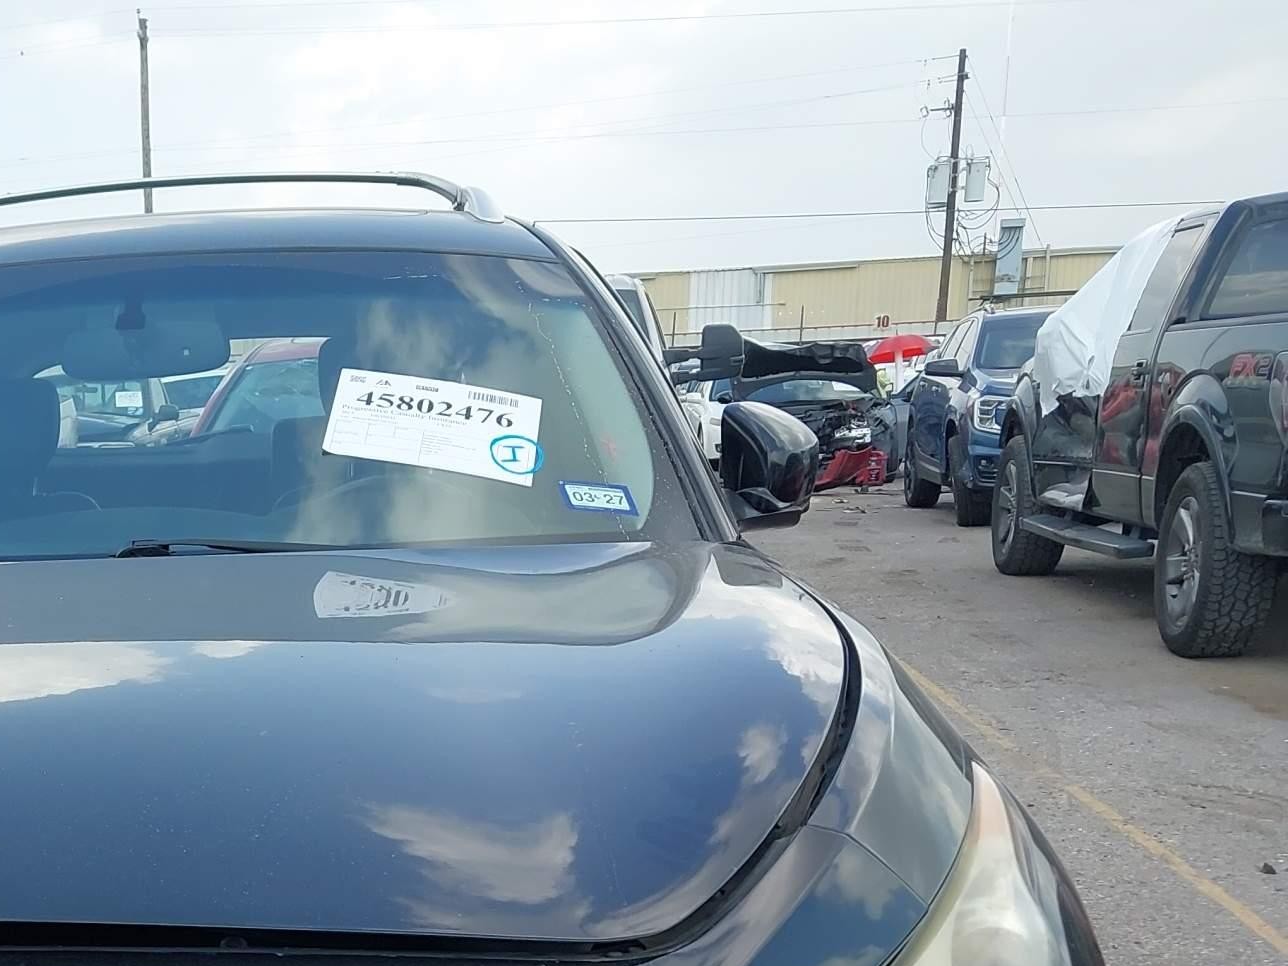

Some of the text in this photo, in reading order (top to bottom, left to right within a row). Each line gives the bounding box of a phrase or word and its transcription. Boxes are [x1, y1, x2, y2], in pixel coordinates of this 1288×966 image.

[875, 314, 890, 328] 10
[1229, 353, 1273, 380] FX2
[355, 390, 514, 428] 45802476
